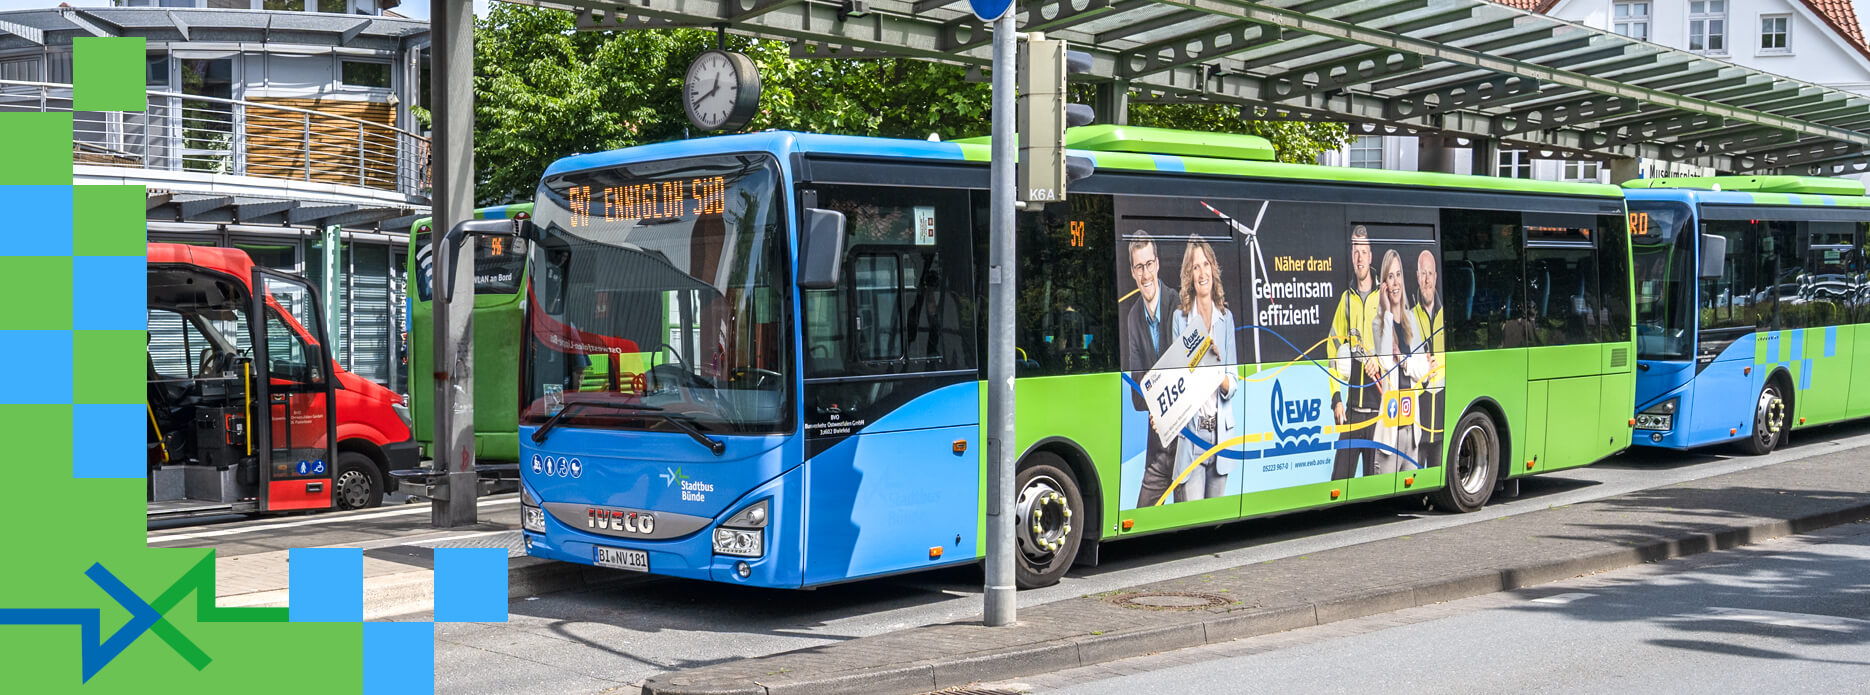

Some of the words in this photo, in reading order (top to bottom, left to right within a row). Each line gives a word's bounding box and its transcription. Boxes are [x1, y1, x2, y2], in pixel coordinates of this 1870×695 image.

[1649, 164, 1701, 178] Museumspl
[569, 185, 591, 227] 547
[604, 180, 684, 222] ENNIGLOH
[692, 176, 725, 215] SÜD
[1029, 188, 1056, 201] K6A
[1070, 220, 1085, 247] 547
[1274, 256, 1305, 271] Näher
[1307, 255, 1332, 271] dran!
[498, 273, 512, 281] Bord
[1255, 277, 1333, 299] Gemeinsam
[1259, 304, 1320, 326] effizient!
[1156, 377, 1186, 418] Else
[1285, 398, 1322, 424] EWB
[681, 480, 714, 492] Stadtbus
[681, 490, 705, 502] Bünde
[588, 508, 655, 534] IVECO
[599, 549, 610, 562] BI
[615, 551, 628, 565] NV
[629, 553, 647, 567] 181
